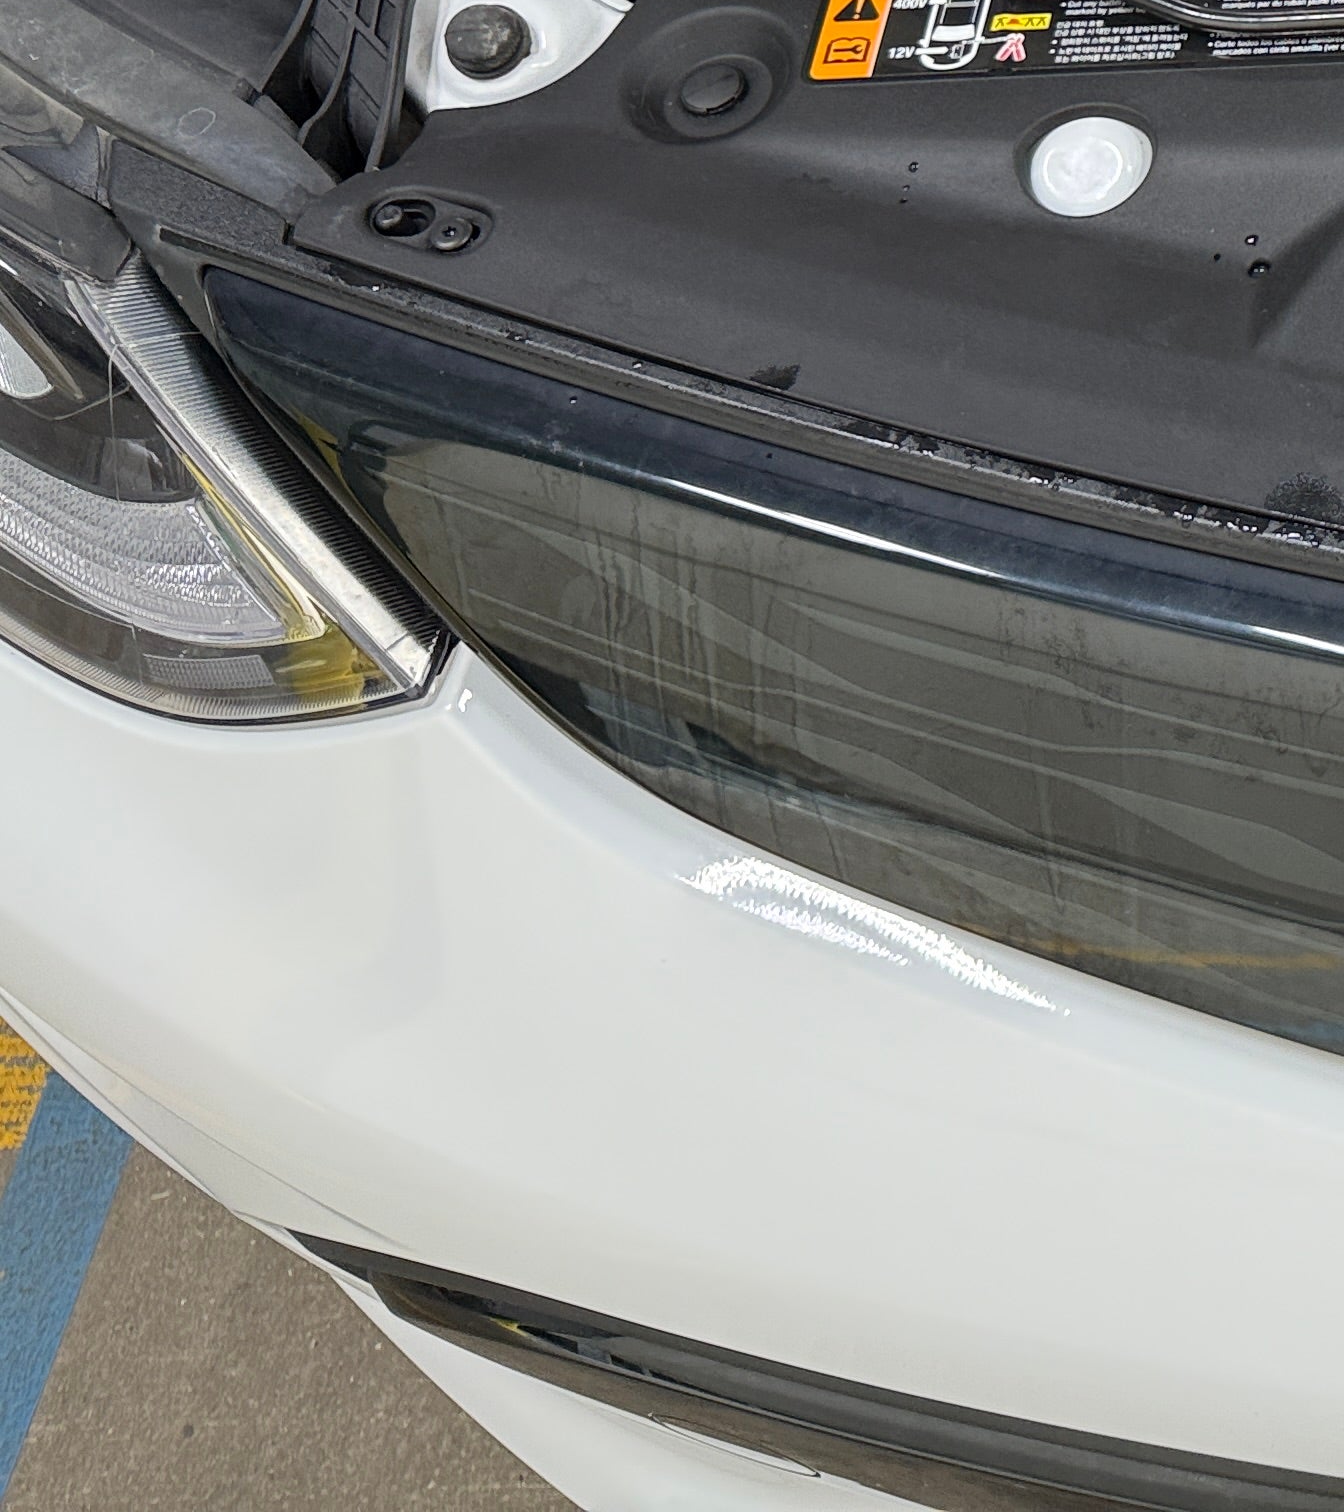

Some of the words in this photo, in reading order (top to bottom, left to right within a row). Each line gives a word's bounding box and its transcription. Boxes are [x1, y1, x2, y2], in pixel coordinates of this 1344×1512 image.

[1213, 40, 1237, 48] Corte
[888, 45, 916, 60] 12V
[1212, 47, 1252, 56] marcados
